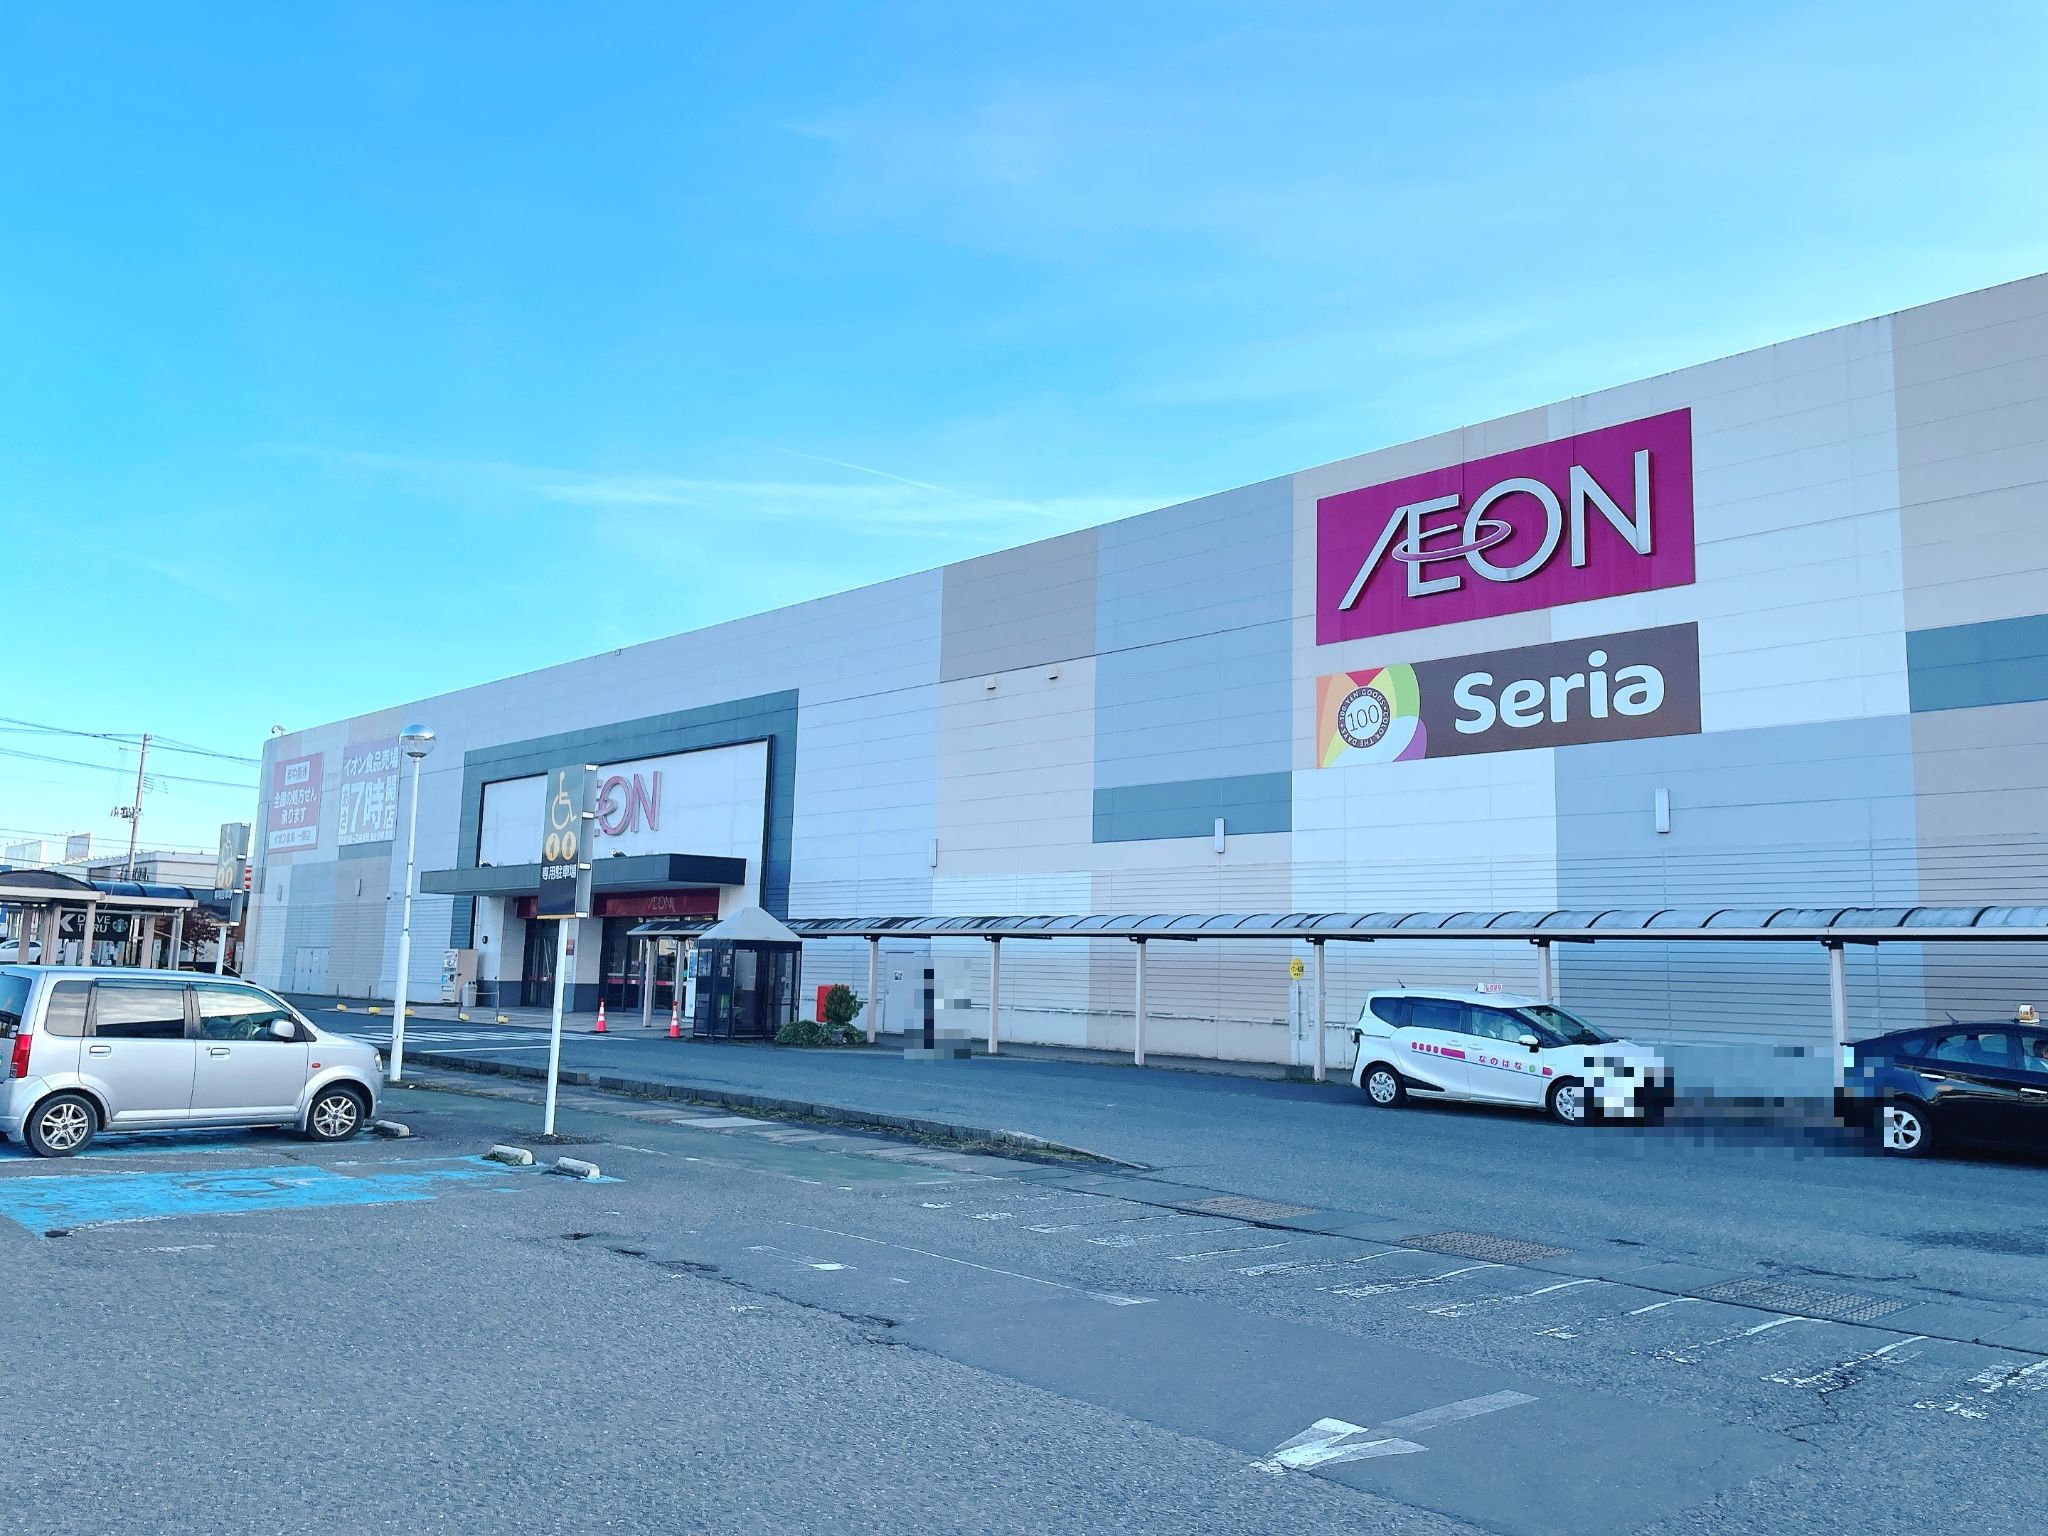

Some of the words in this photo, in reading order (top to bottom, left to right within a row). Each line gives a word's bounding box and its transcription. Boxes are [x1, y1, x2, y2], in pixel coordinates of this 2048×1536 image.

[1362, 689, 1385, 705] GOODS
[1453, 650, 1666, 735] Seria
[1347, 704, 1380, 731] 100
[344, 747, 399, 777] イオン食品売場
[594, 770, 662, 837] ON
[542, 864, 576, 880] 専用駐車場
[77, 914, 111, 924] DVE
[77, 923, 108, 933] TRU
[1478, 1055, 1522, 1070] なのはな
